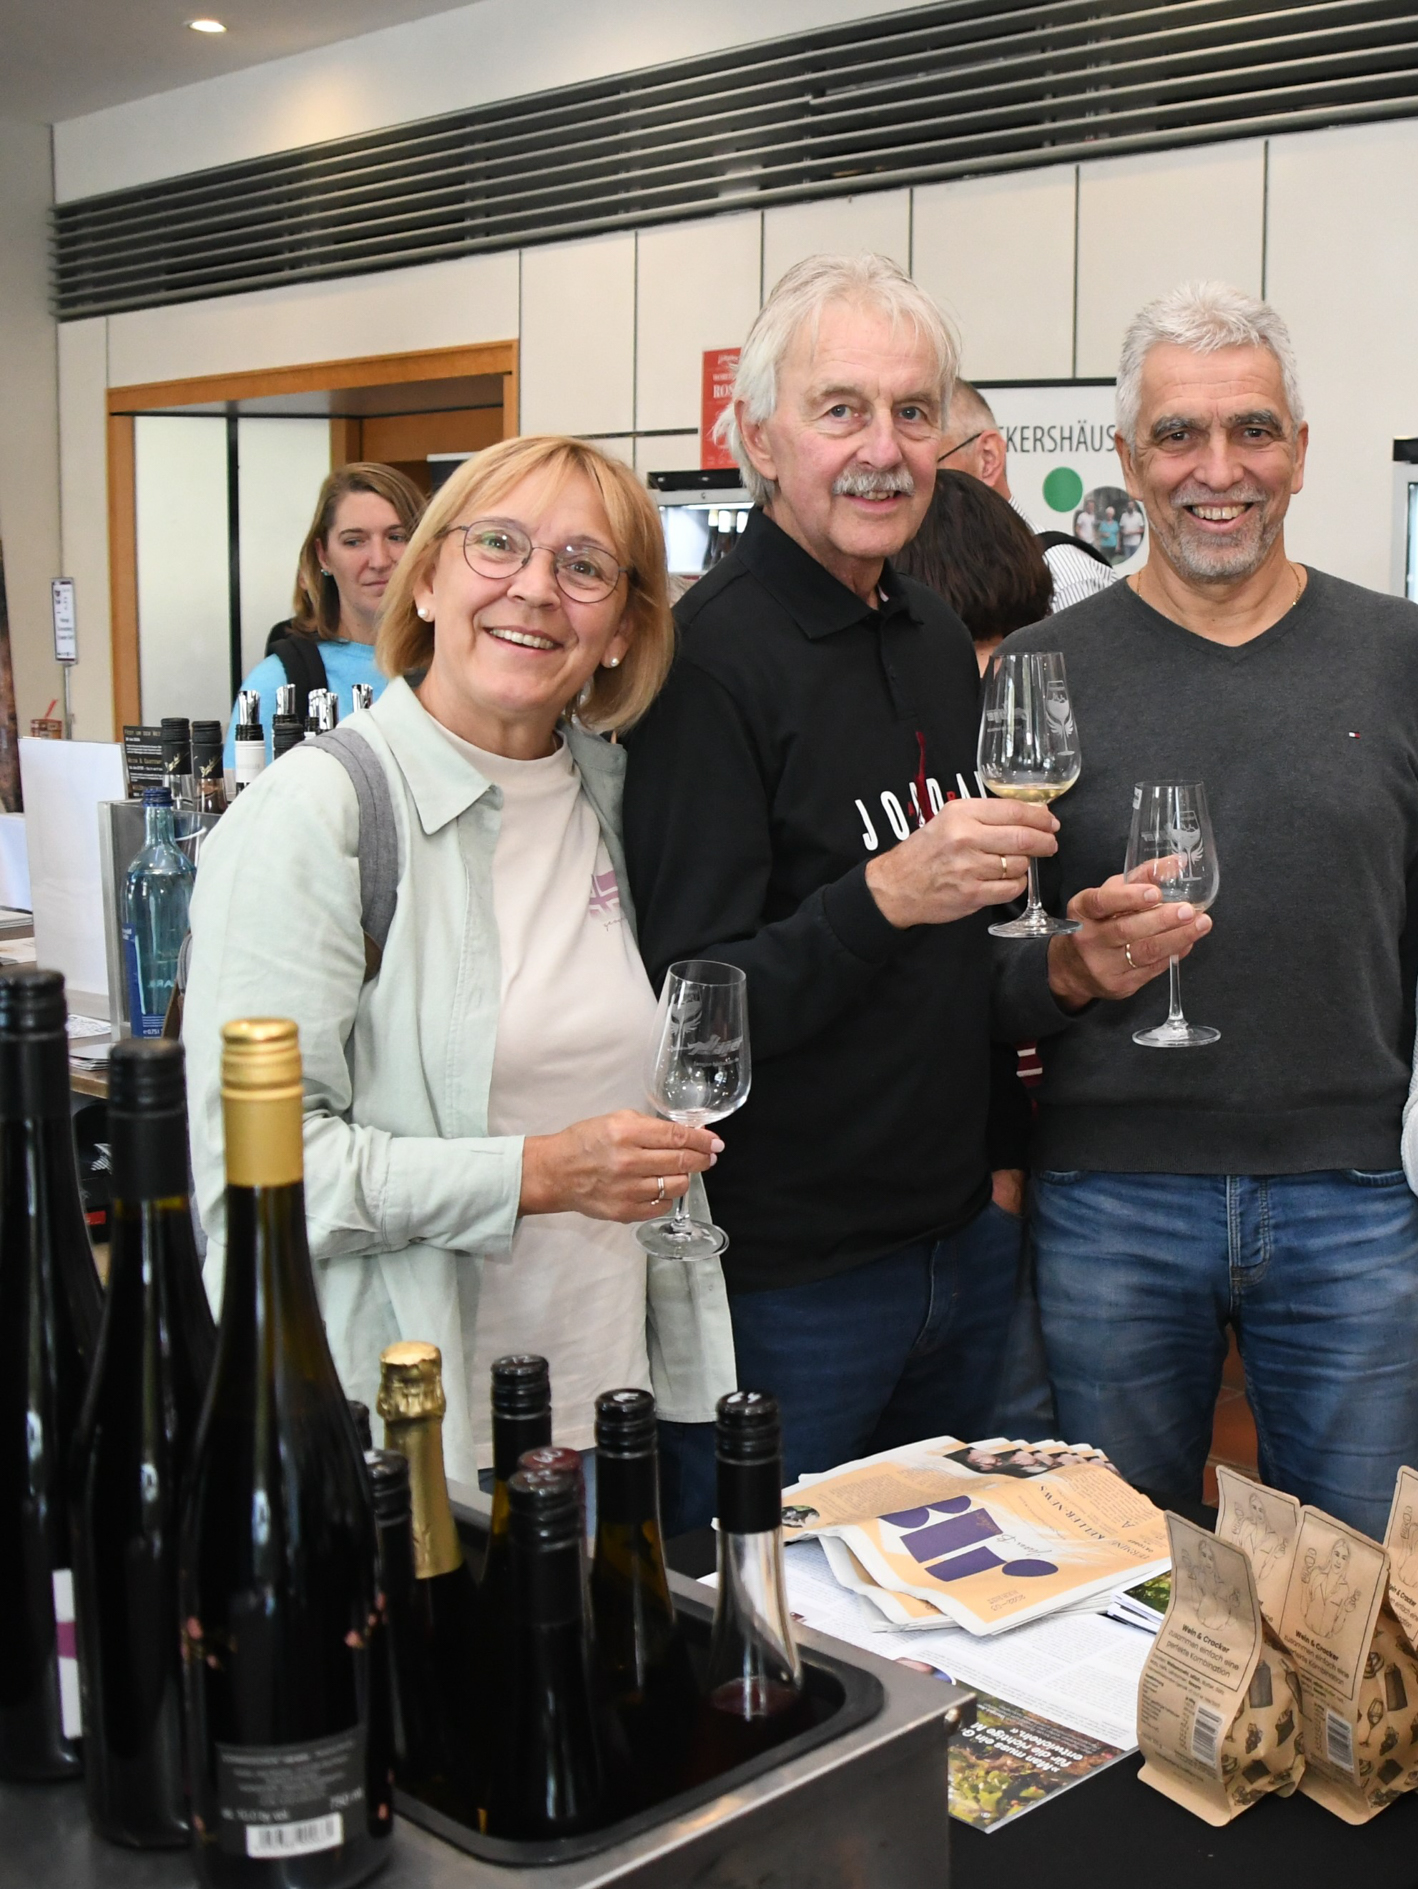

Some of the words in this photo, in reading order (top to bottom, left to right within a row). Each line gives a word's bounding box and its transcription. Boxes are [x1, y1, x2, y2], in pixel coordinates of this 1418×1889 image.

[999, 420, 1116, 453] KERSHÄUS
[1041, 1486, 1105, 1540] KELLER-NEWS
[1182, 1624, 1196, 1636] Wein
[1203, 1635, 1230, 1653] Cracker
[1296, 1630, 1309, 1644] Wein
[1316, 1643, 1339, 1661] Cracker
[1190, 1652, 1230, 1678] Kombination
[1200, 1647, 1223, 1663] einfach
[1224, 1658, 1239, 1671] eine
[975, 1733, 995, 1746] ein
[986, 1728, 1032, 1750] richtige
[994, 1741, 1026, 1758] muss
[1029, 1747, 1051, 1759] die
[1049, 1754, 1072, 1768] für
